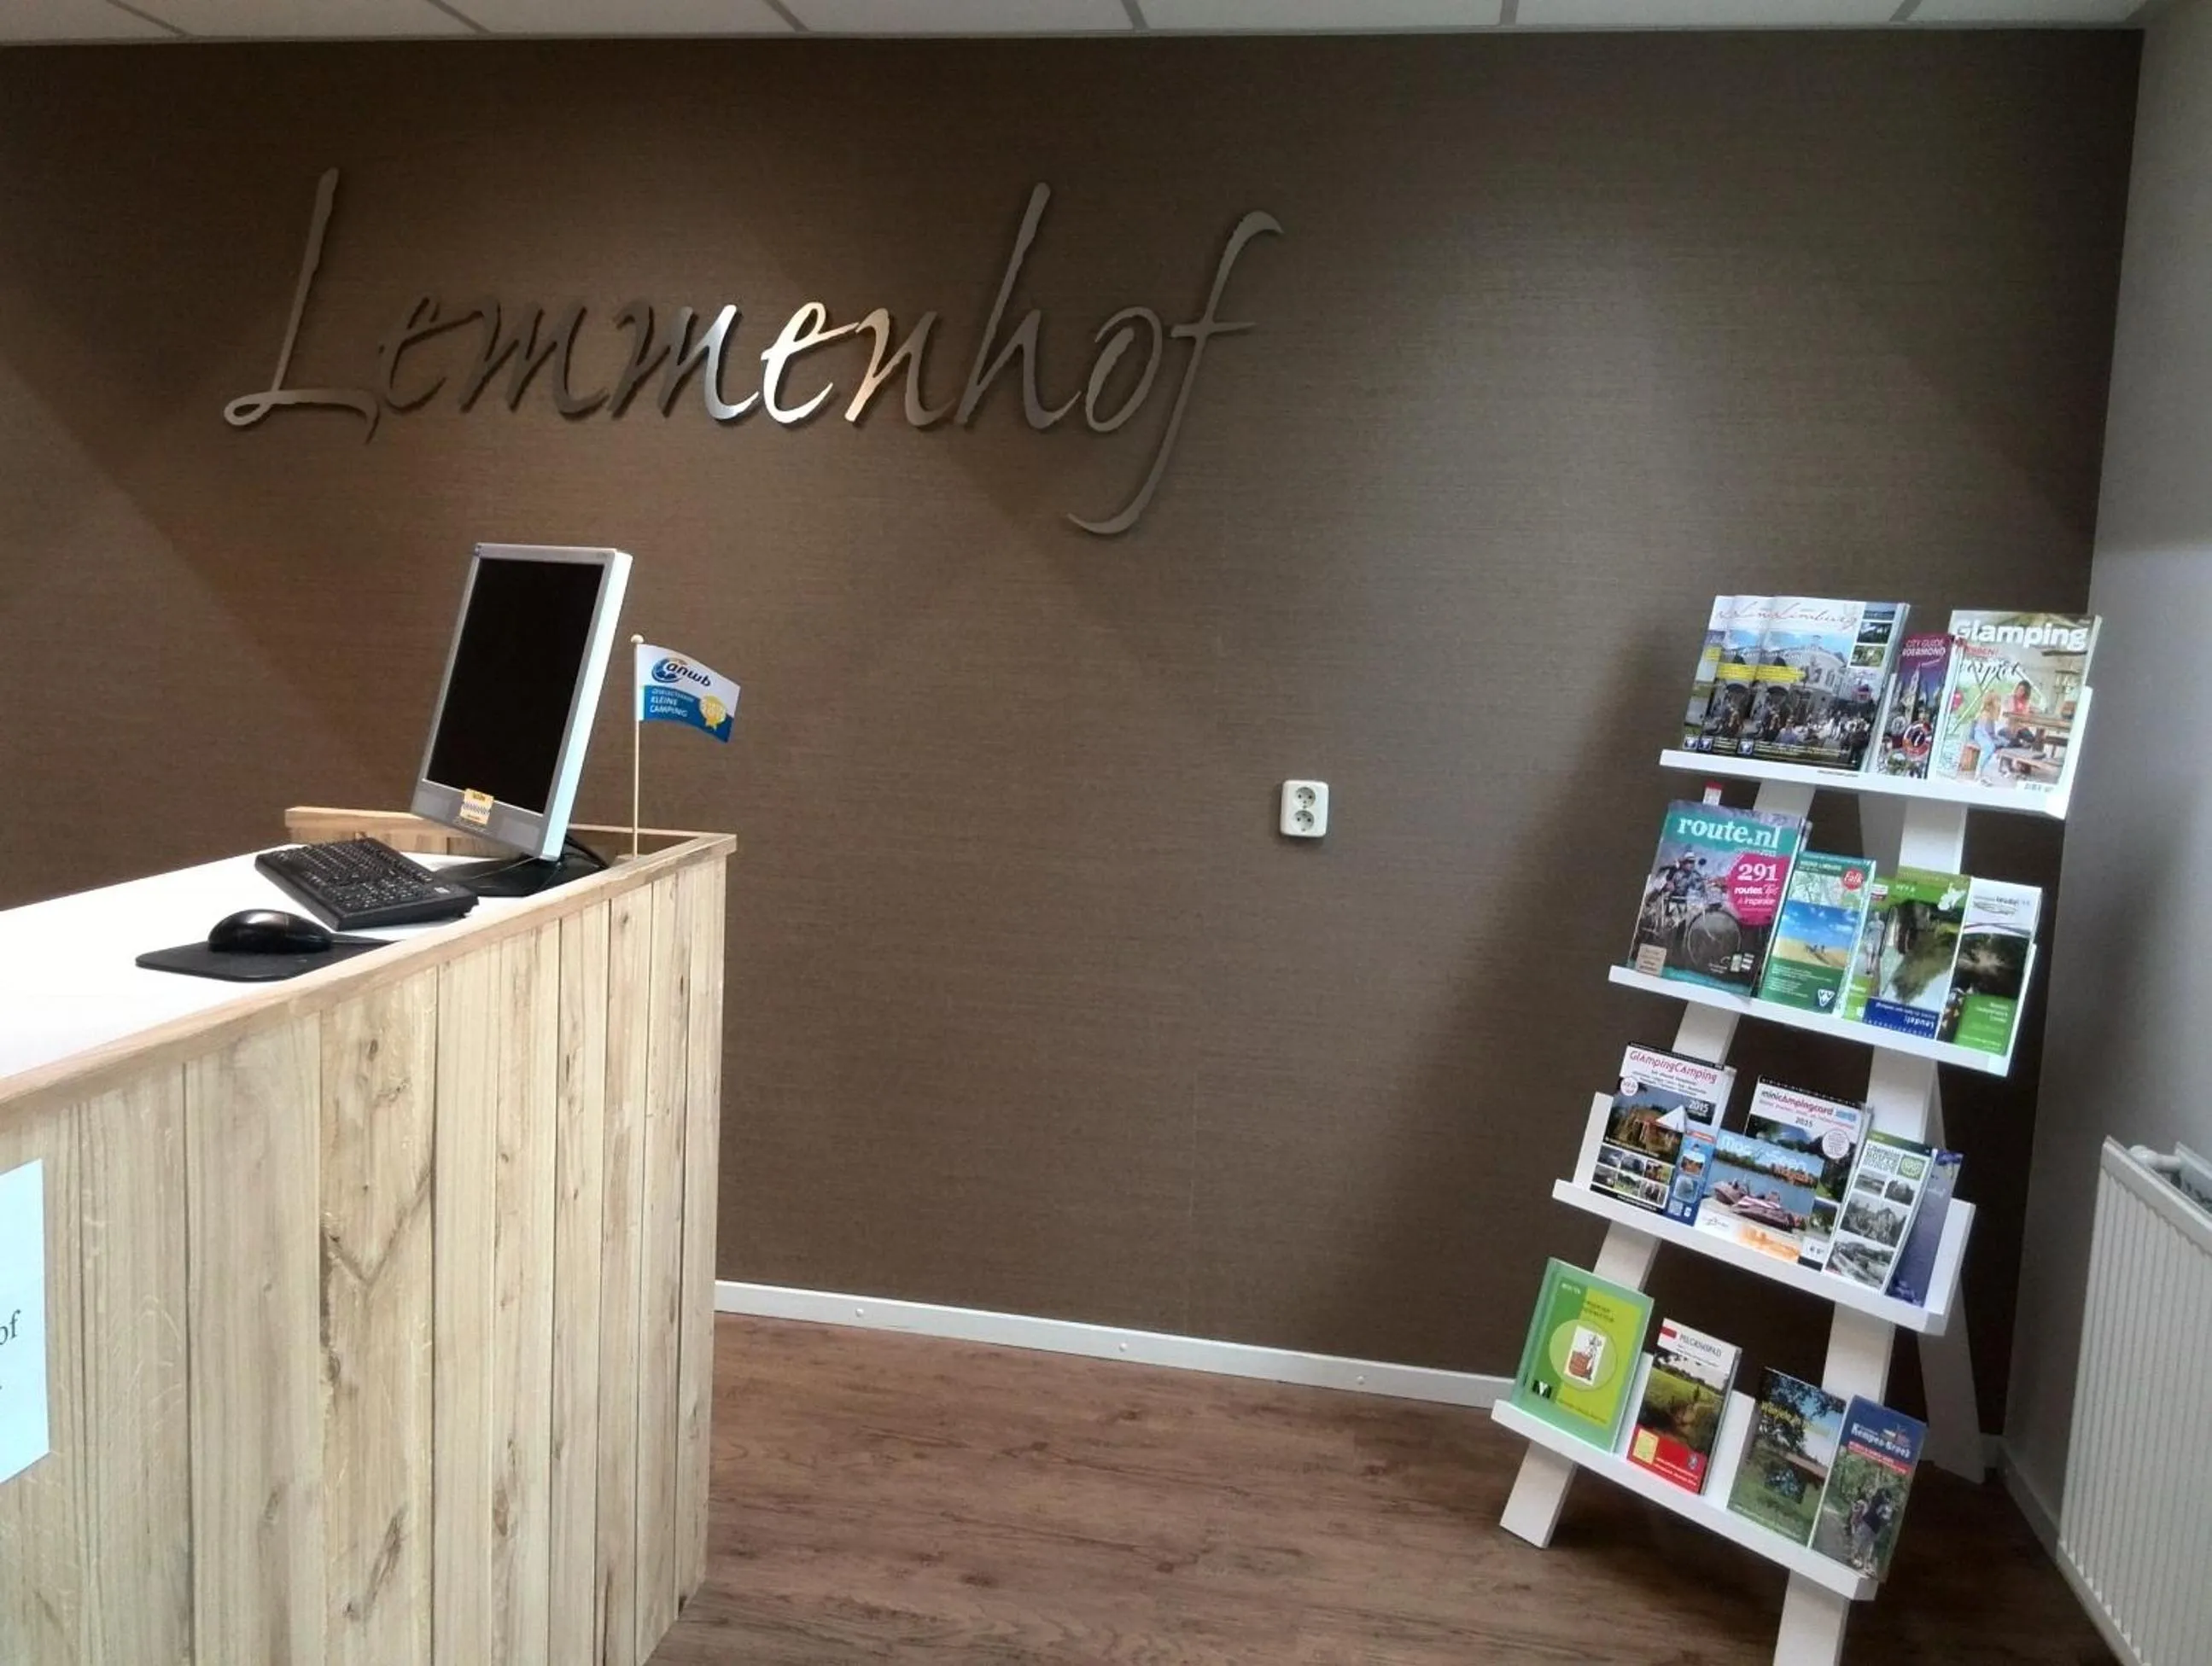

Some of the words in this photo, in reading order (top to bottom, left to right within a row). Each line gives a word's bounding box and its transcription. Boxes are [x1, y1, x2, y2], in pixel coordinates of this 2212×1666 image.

[222, 167, 1284, 536] Lemmenhof
[1955, 620, 2088, 651] Glamping
[666, 661, 712, 687] anwb
[649, 705, 688, 718] CAMPING
[1677, 817, 1781, 848] route.nl
[1736, 863, 1778, 882] 291
[1843, 869, 1864, 886] Falk
[1734, 885, 1763, 895] routes
[1688, 1099, 1709, 1114] 2015
